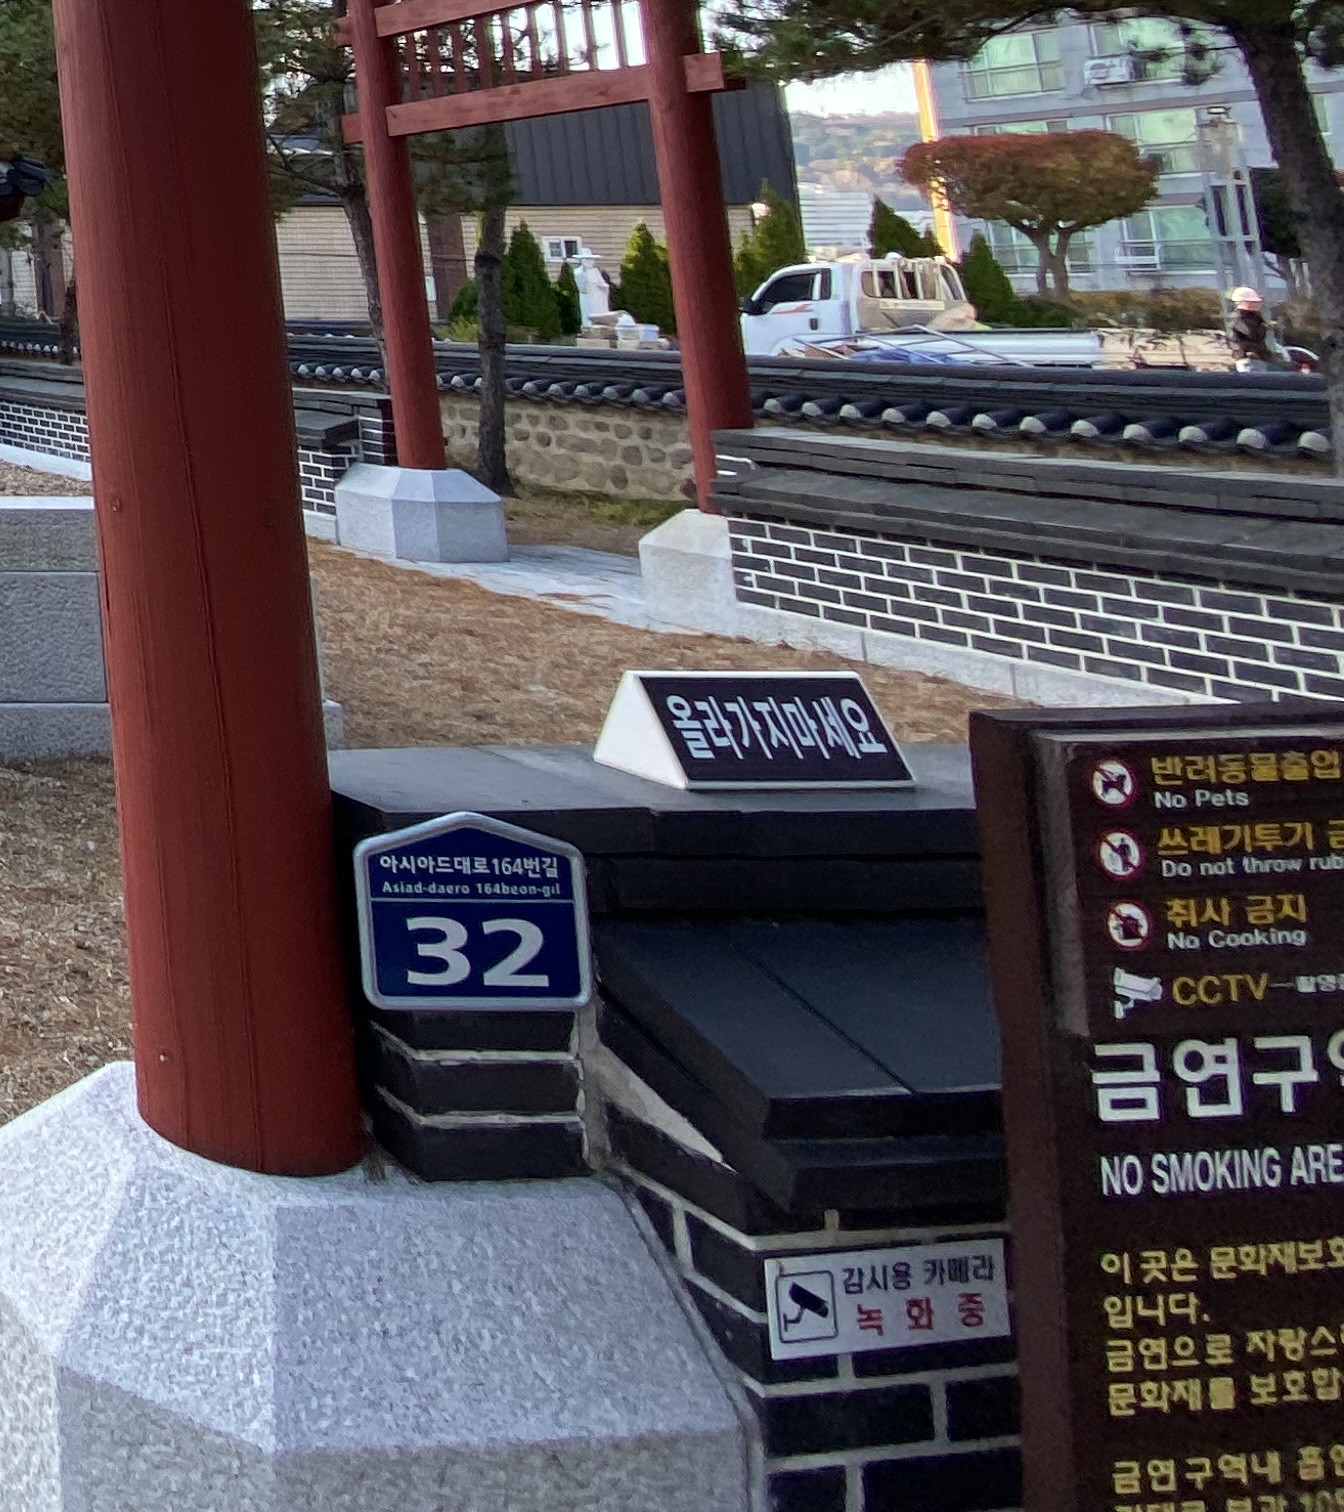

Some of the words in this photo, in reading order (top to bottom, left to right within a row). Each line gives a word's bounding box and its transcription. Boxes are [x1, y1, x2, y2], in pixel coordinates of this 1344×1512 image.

[666, 694, 888, 760] 올라가지마세요
[1154, 791, 1188, 809] No
[1195, 789, 1250, 807] Pets
[1157, 821, 1315, 856] 쓰레기투기
[379, 855, 559, 879] 아시아드대로164번길
[1161, 859, 1192, 878] Do
[1199, 858, 1236, 876] not
[1242, 856, 1303, 874] throw
[382, 880, 471, 895] Asiad-daero
[476, 882, 561, 898] 164beon-gil
[1166, 897, 1231, 928] 취사
[1244, 893, 1308, 925] 금지
[406, 916, 550, 987] 32
[1167, 932, 1201, 950] No
[1208, 928, 1308, 948] Cooking
[1171, 972, 1269, 1006] CCTV
[1091, 1028, 1344, 1123] 금연구
[1099, 1154, 1144, 1197] NO
[1151, 1146, 1283, 1195] SMOKING
[842, 1261, 913, 1295] 감시용
[923, 1255, 996, 1286] 카메라
[1100, 1251, 1133, 1285] 이
[1139, 1248, 1200, 1285] 곳은
[1103, 1291, 1211, 1330] 입니다.
[1106, 1333, 1235, 1373] 금연으로
[1245, 1323, 1344, 1363] 자랑스
